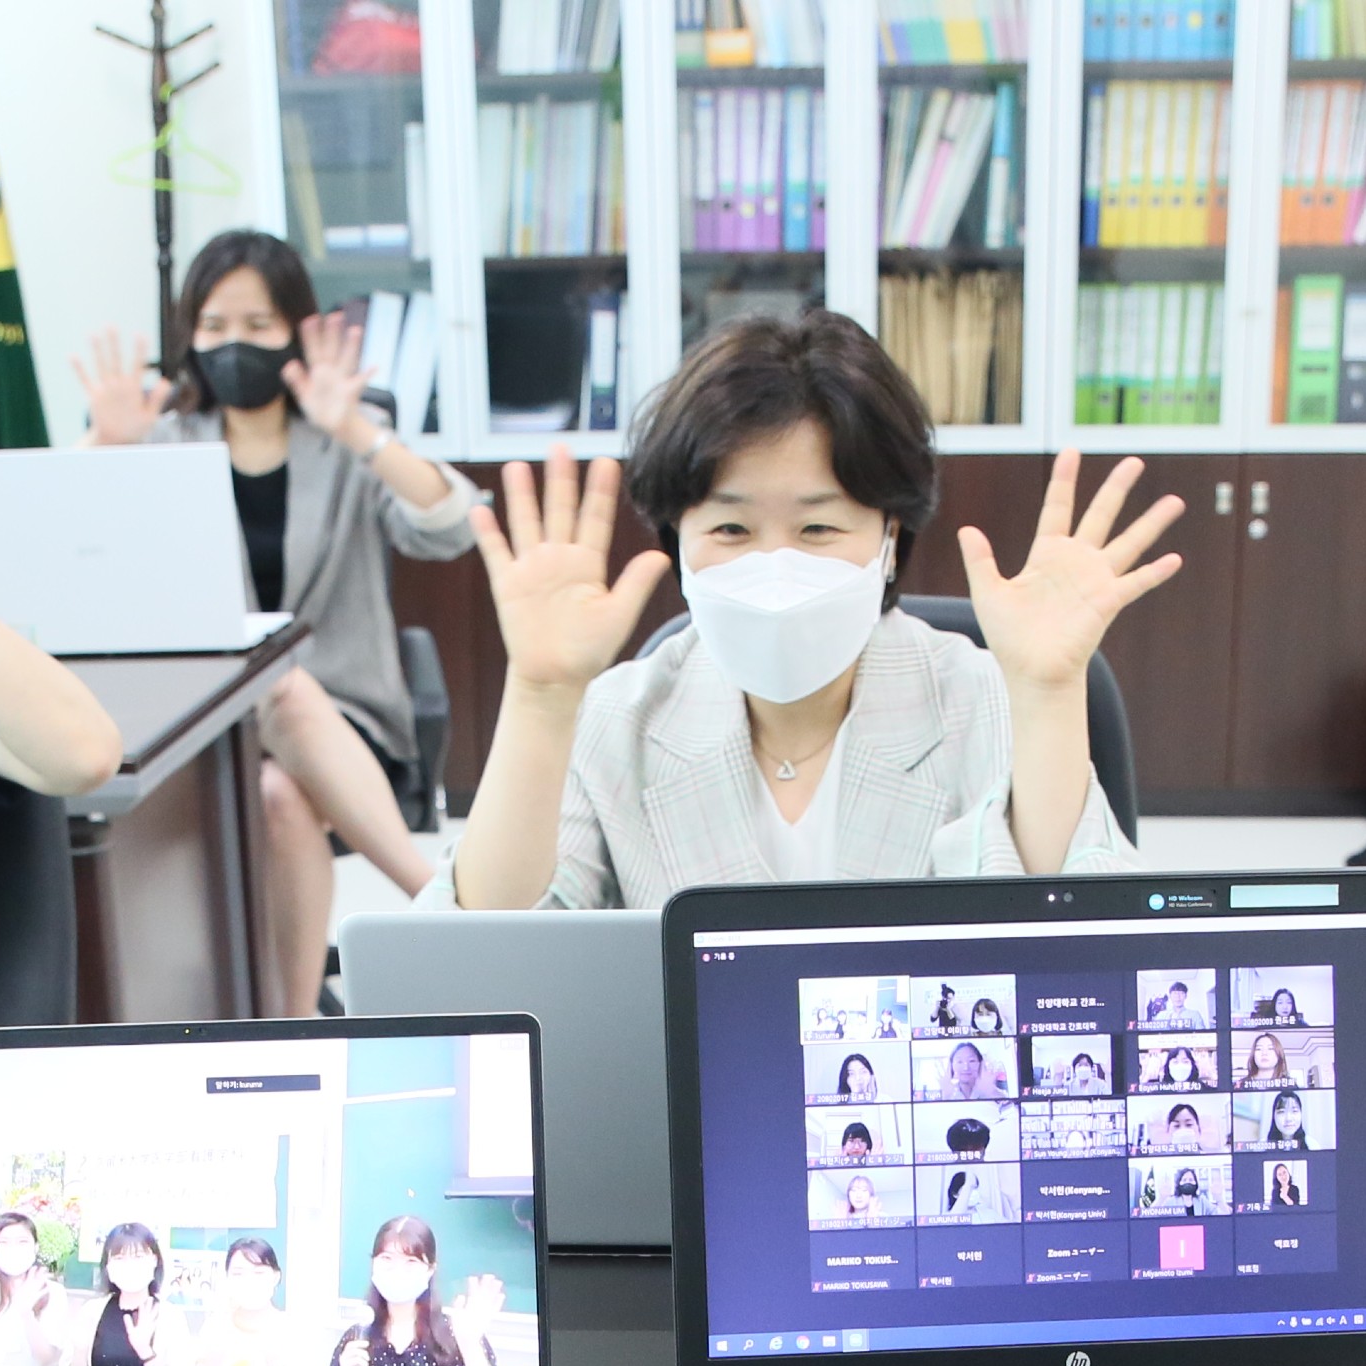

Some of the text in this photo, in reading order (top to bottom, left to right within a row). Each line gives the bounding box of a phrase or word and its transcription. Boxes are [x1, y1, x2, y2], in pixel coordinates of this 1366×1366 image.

[1036, 998, 1078, 1009] 건양대학교
[1031, 1021, 1097, 1032] 건양대학교 간호대학
[1052, 1087, 1068, 1095] Jung
[928, 1216, 958, 1224] KURUME
[826, 1257, 862, 1266] MARIKO
[1142, 1269, 1193, 1279] Miyamoto Izumi
[823, 1281, 888, 1290] MARIKO TOKUSAWA
